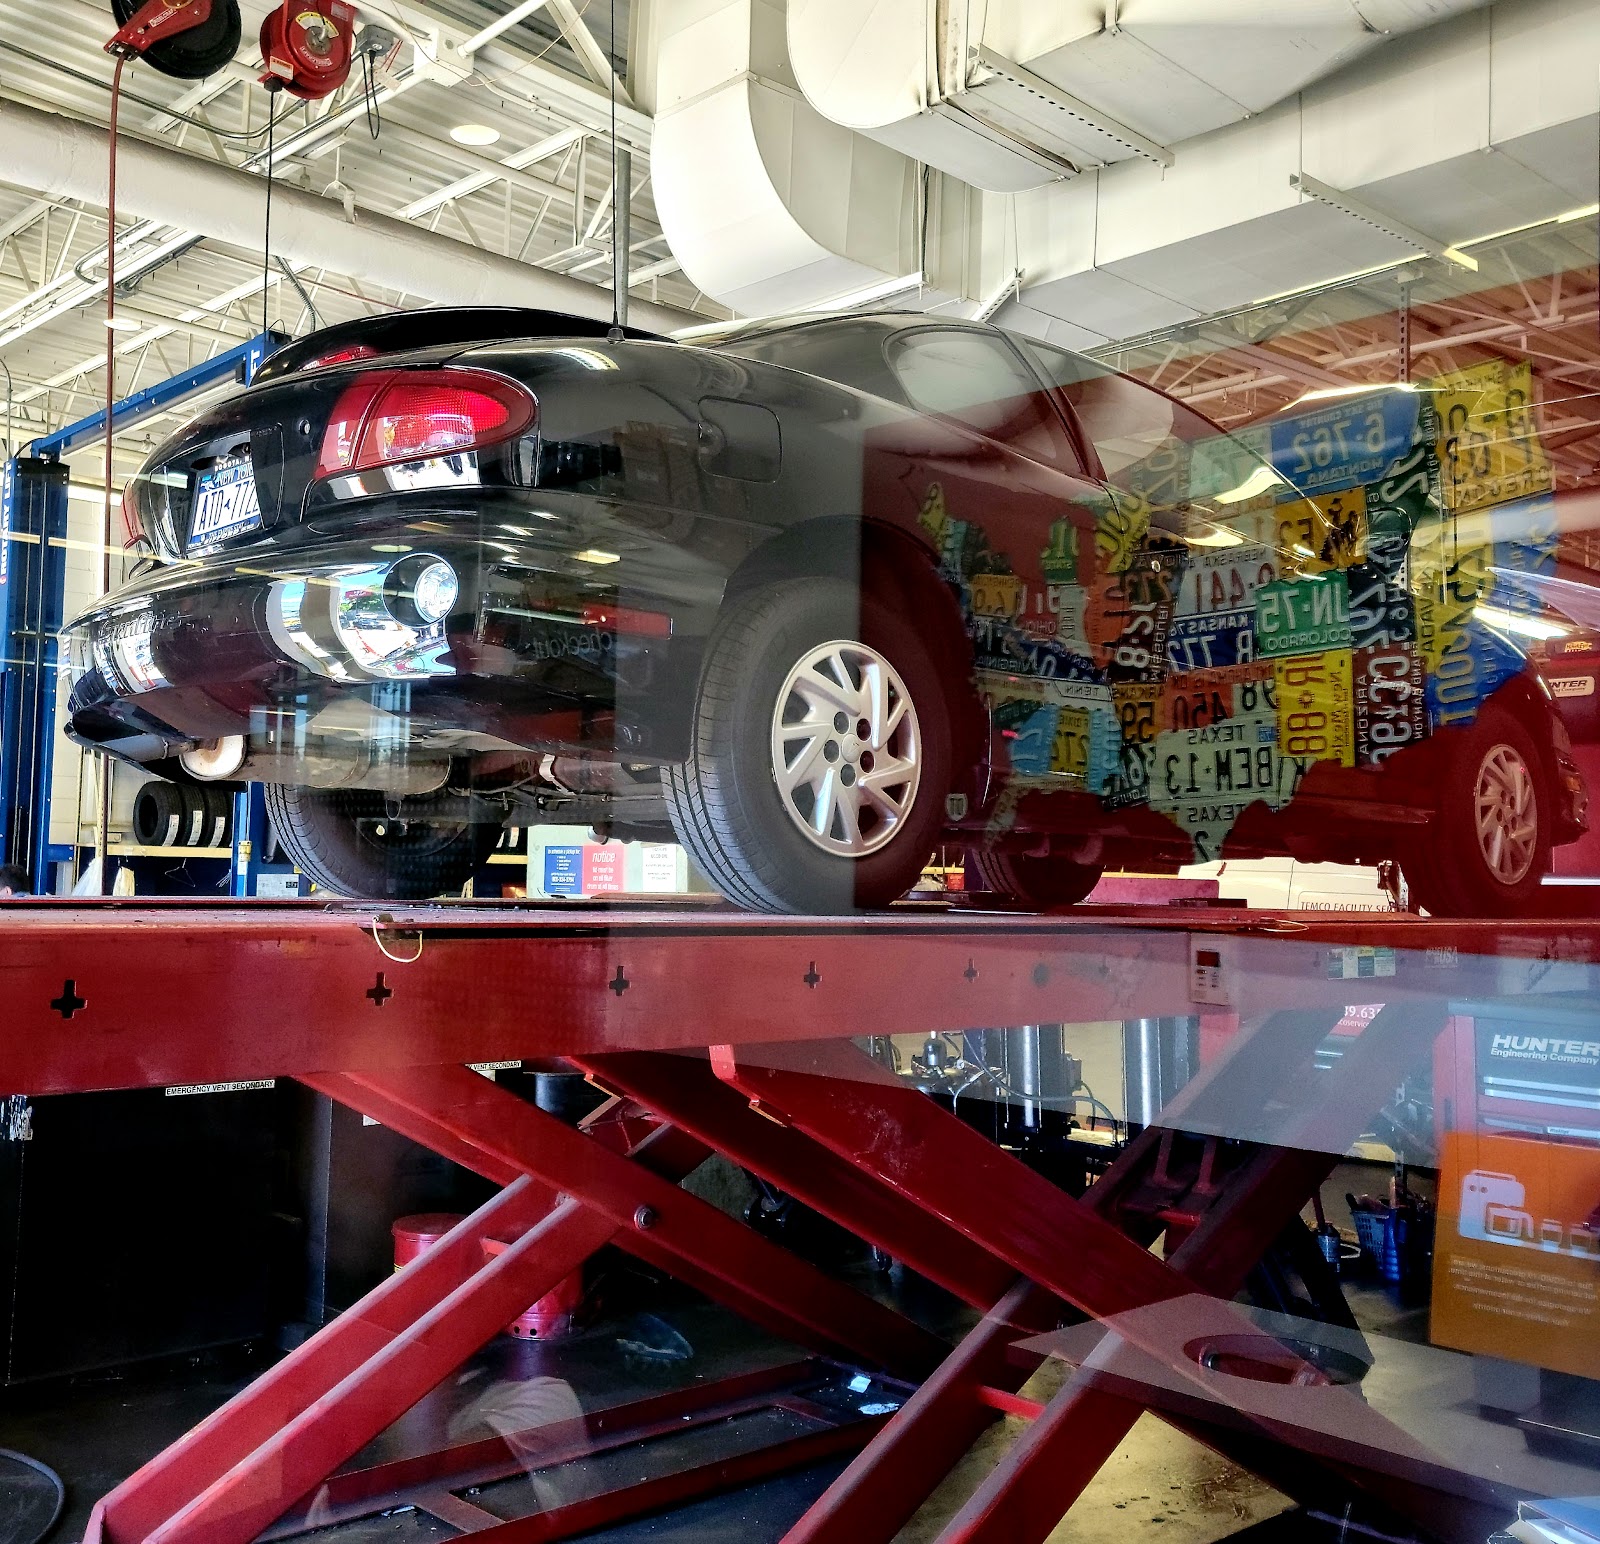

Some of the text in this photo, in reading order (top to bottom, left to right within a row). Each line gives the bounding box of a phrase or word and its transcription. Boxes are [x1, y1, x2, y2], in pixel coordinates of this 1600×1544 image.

[217, 467, 236, 487] NEW
[592, 850, 615, 862] notice
[1301, 902, 1331, 911] TEMCO
[1334, 903, 1373, 912] FACILITY
[1491, 1034, 1600, 1057] HUNTER
[1490, 1048, 1599, 1066] Engineering Company
[488, 1061, 521, 1069] SECONDARY
[166, 1080, 274, 1095] EMERGENCY VENT SECONDARY
